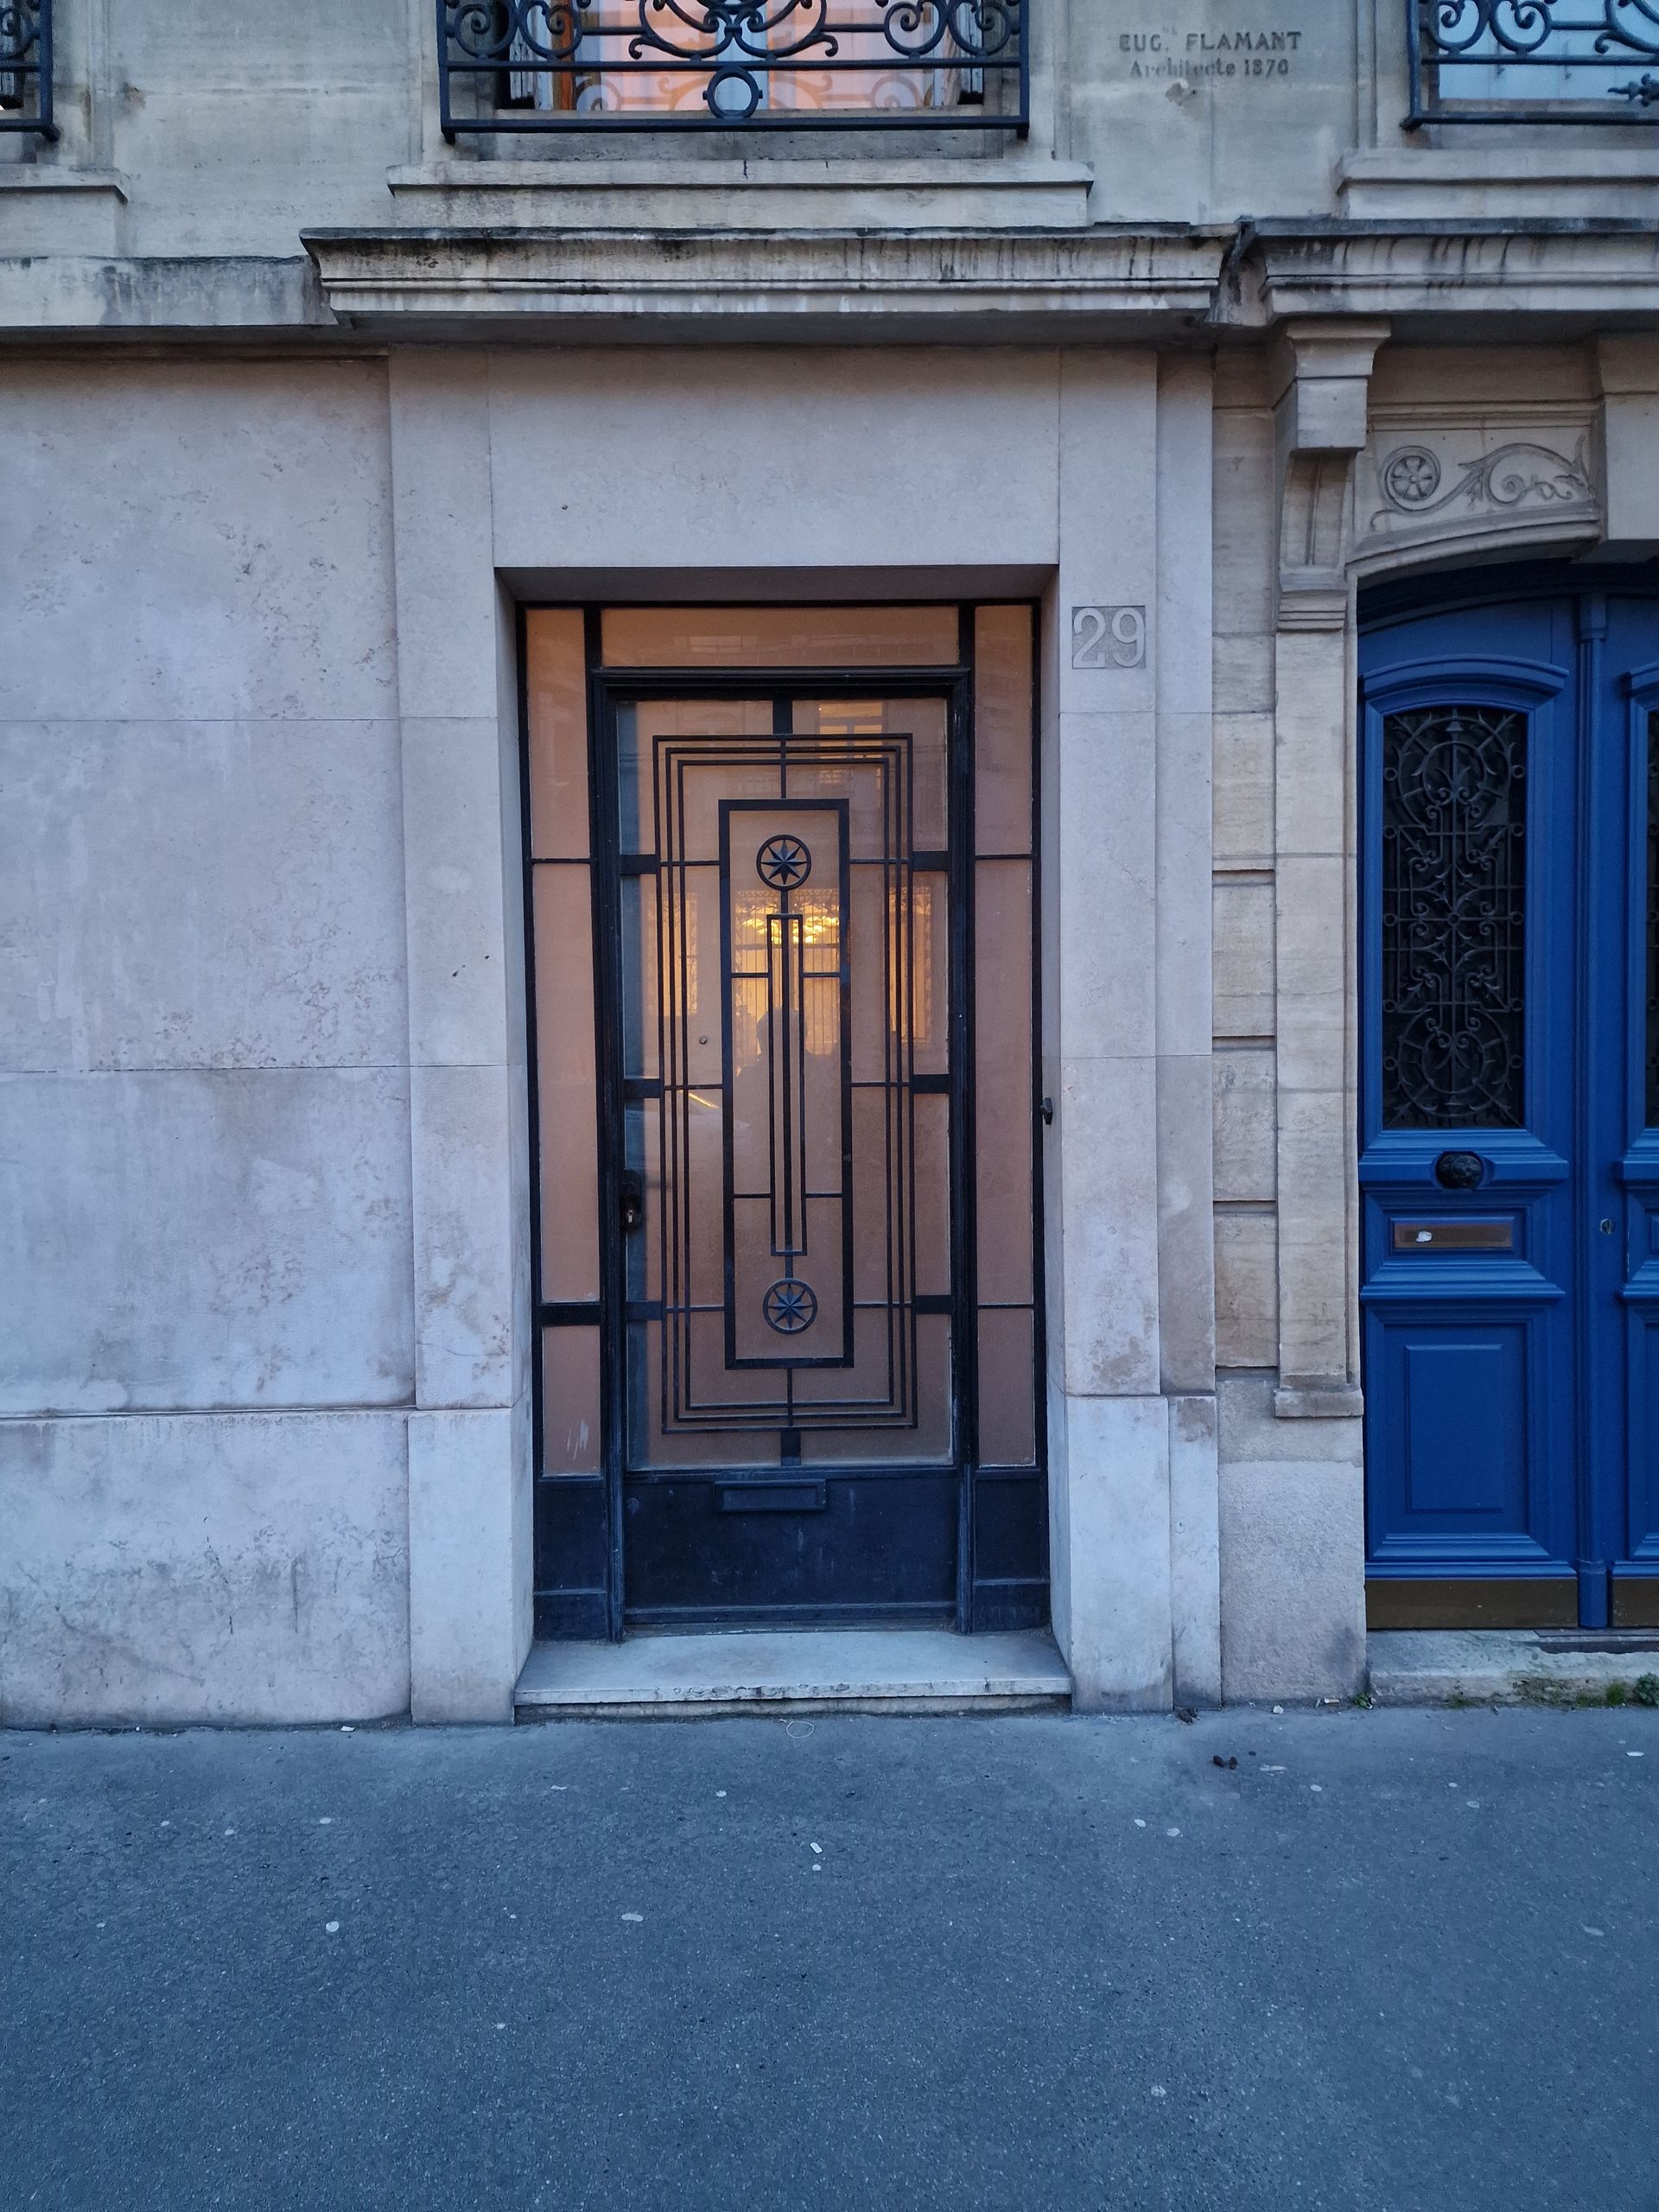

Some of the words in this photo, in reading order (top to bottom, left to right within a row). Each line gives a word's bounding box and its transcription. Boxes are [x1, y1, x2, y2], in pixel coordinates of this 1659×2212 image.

[1119, 33, 1169, 52] EUG.
[1185, 31, 1302, 52] FLAMANT
[1129, 57, 1236, 78] Architecte
[1244, 58, 1289, 78] 1870
[1072, 607, 1145, 669] 29
